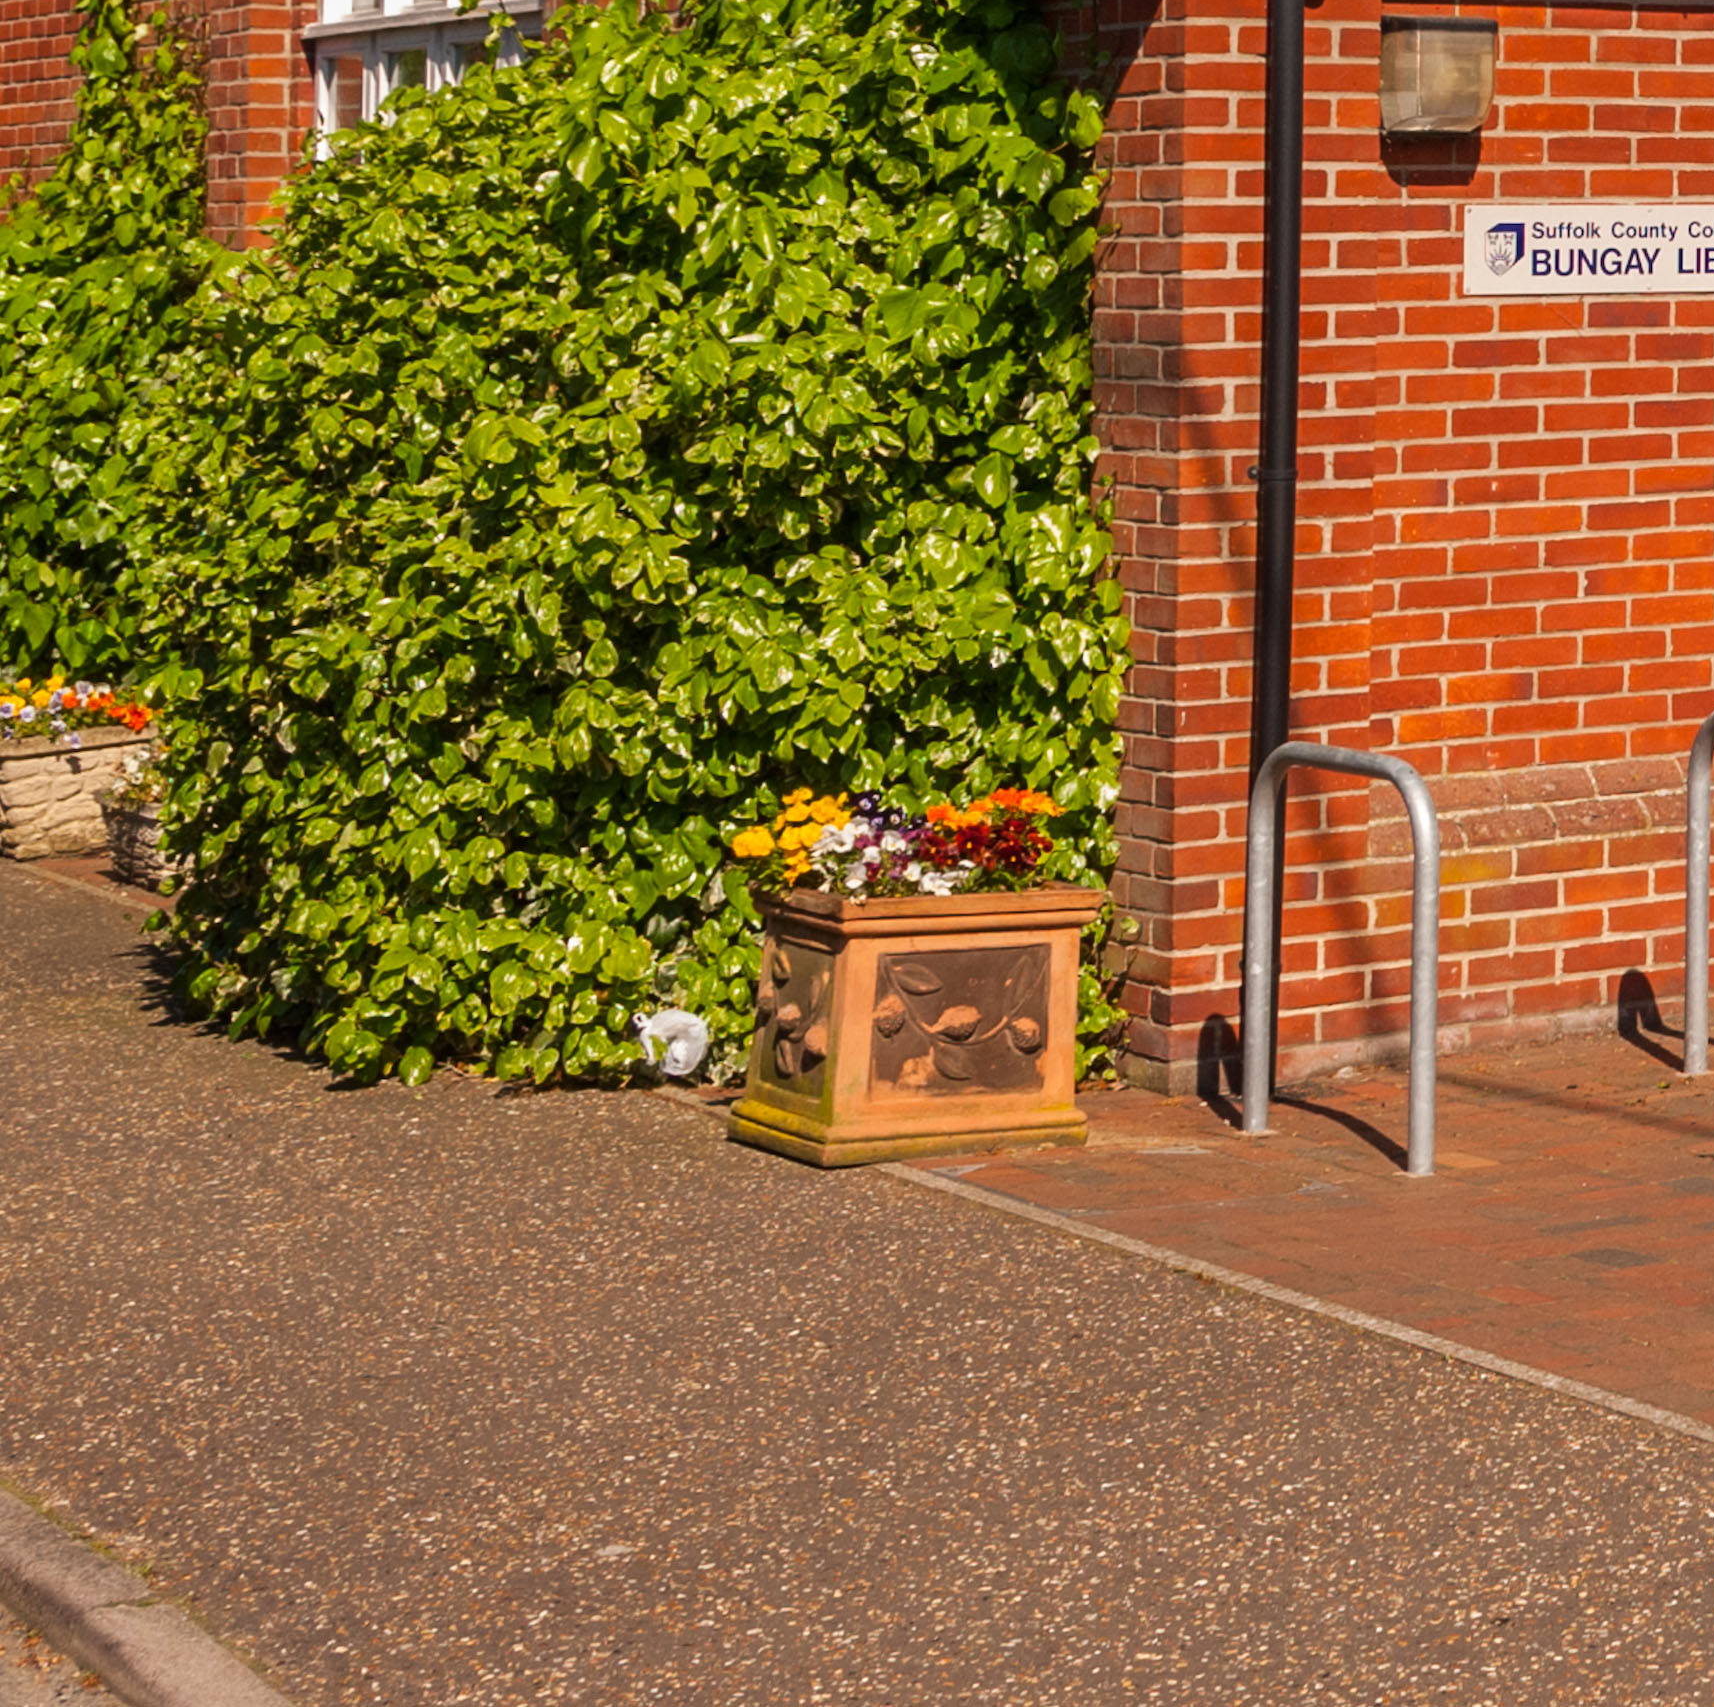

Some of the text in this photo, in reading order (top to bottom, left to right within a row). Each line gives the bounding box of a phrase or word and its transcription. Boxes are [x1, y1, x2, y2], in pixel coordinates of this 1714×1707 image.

[1530, 221, 1602, 240] Suffolk
[1611, 221, 1678, 243] County
[1530, 247, 1661, 277] BUNGAY
